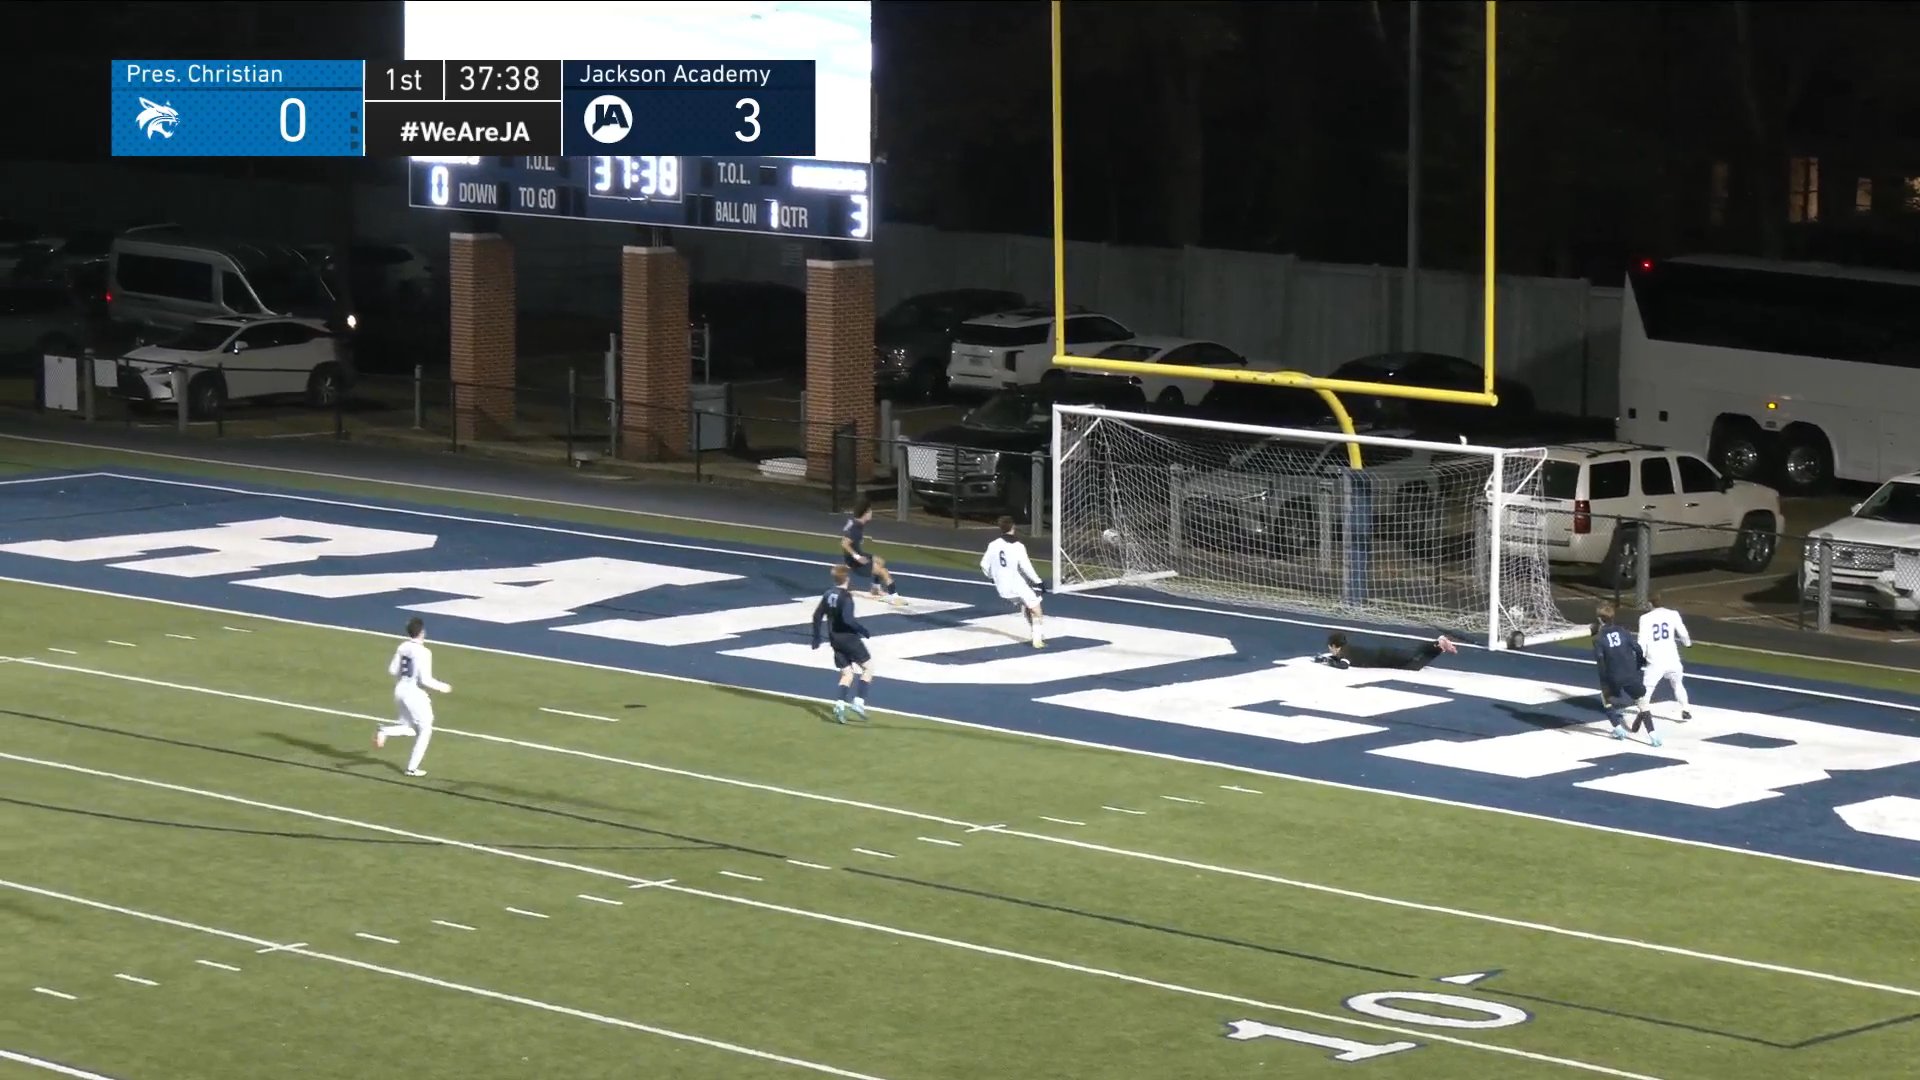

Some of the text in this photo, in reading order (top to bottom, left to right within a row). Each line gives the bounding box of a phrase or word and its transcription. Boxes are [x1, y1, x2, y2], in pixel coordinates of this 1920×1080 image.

[717, 161, 751, 185] T.O.L.
[431, 165, 449, 206] 0
[458, 182, 497, 205] DOWN
[518, 187, 557, 210] TO GO
[715, 201, 757, 225] BALL ON
[780, 206, 808, 229] QTR
[850, 194, 868, 237] 3
[999, 550, 1007, 567] 6
[1606, 631, 1621, 648] 13
[1652, 622, 1669, 642] 26
